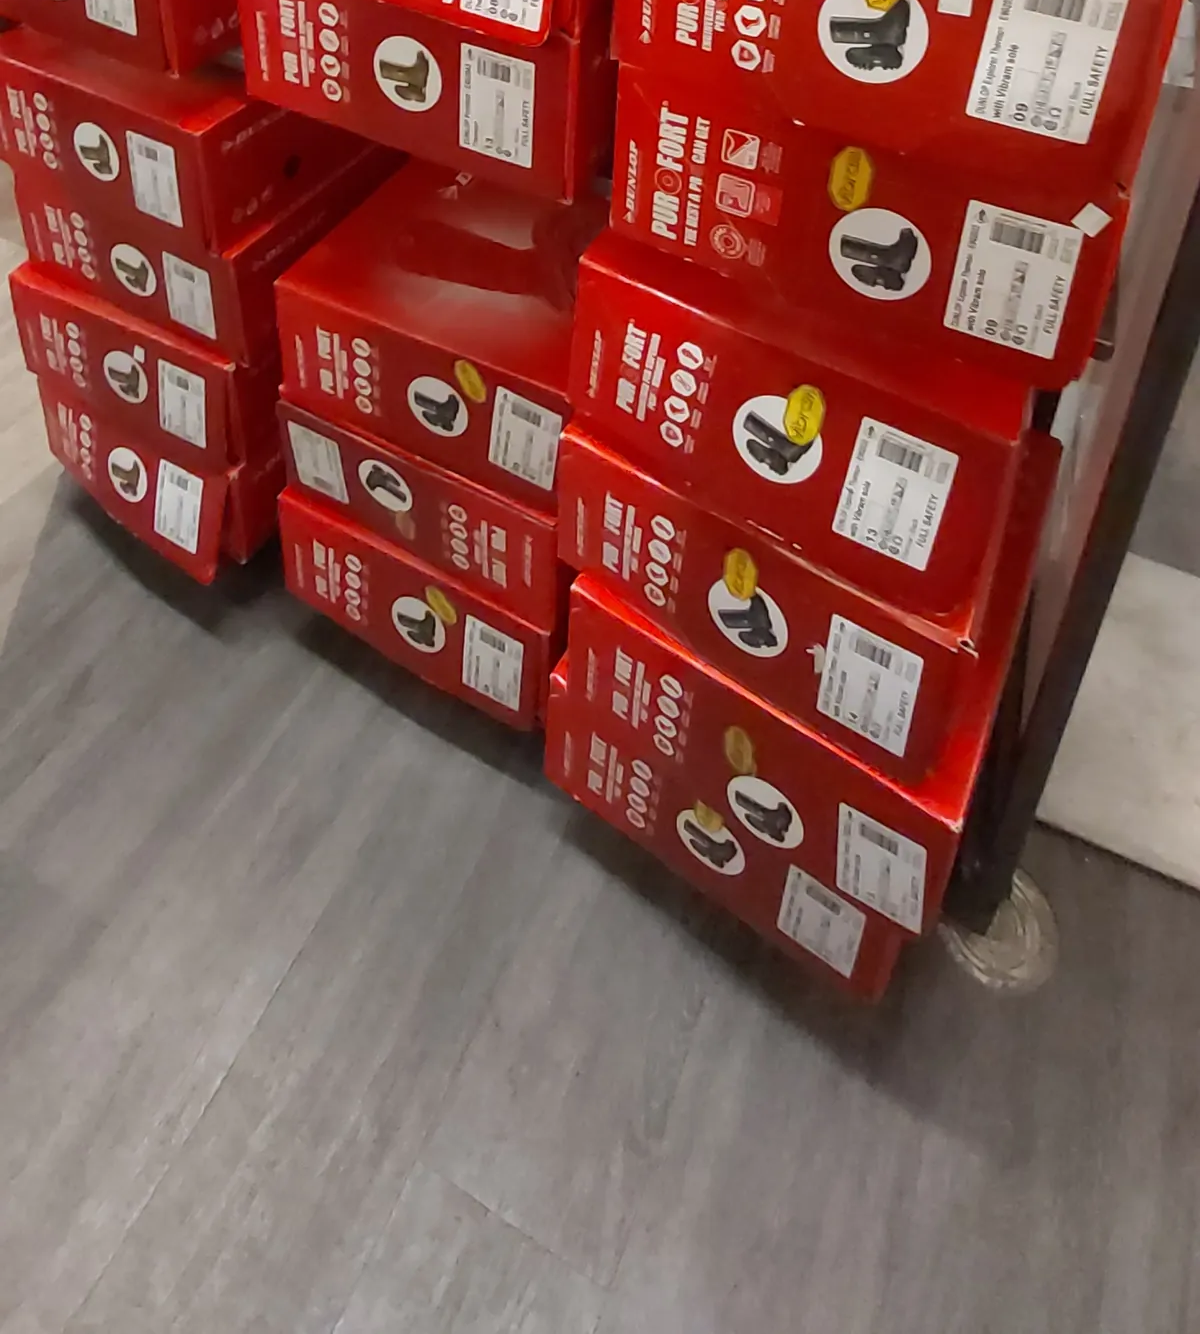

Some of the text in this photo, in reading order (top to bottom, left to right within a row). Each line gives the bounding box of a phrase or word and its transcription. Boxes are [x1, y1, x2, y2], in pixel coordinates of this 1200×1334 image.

[974, 85, 990, 114] DUNLOP
[982, 56, 998, 84] Explorer
[992, 44, 1020, 118] with Vibram sole
[1079, 46, 1108, 116] FULL SAFETY
[1012, 102, 1028, 122] 09
[694, 116, 710, 140] GET
[692, 140, 708, 164] CAN
[625, 139, 638, 212] DUNLOP
[688, 192, 700, 202] A
[968, 287, 982, 314] Vibram
[1042, 275, 1066, 334] FULL SAFETY
[967, 315, 976, 331] with
[616, 322, 647, 414] PURFORT
[852, 497, 866, 522] Vibram
[914, 494, 939, 548] FULL SAFETY
[864, 528, 878, 543] 13
